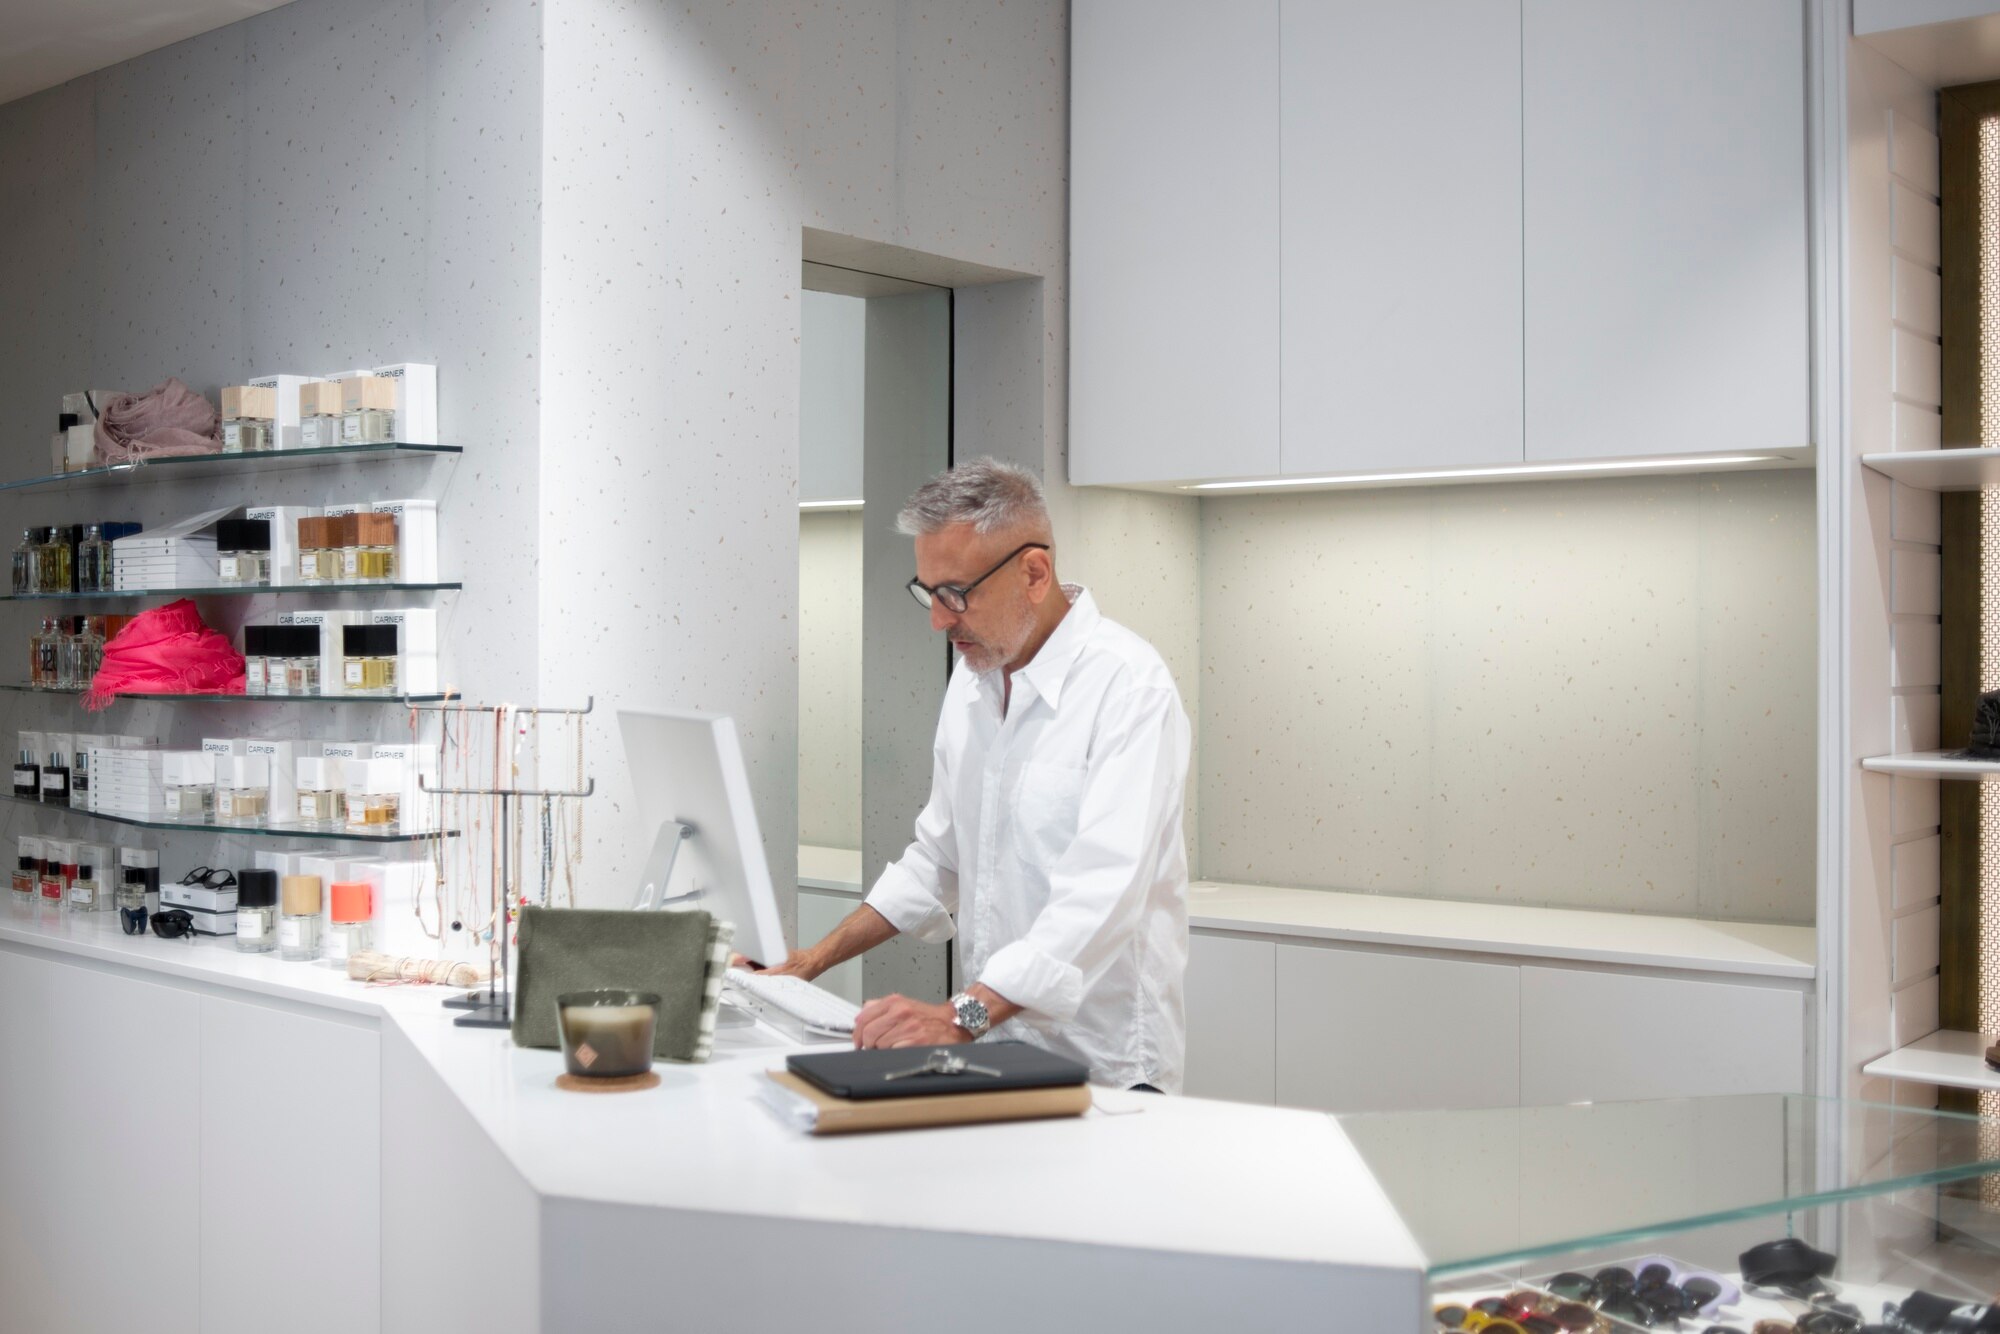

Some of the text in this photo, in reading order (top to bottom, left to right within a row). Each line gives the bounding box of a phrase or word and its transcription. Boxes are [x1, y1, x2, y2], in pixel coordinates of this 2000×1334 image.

[248, 511, 276, 521] CARNER
[295, 616, 324, 625] CARNER
[374, 615, 404, 624] CARNER
[204, 743, 229, 752] CARNER
[248, 745, 275, 754] CARNER
[324, 748, 353, 757] CARNER
[374, 751, 404, 760] CARNER
